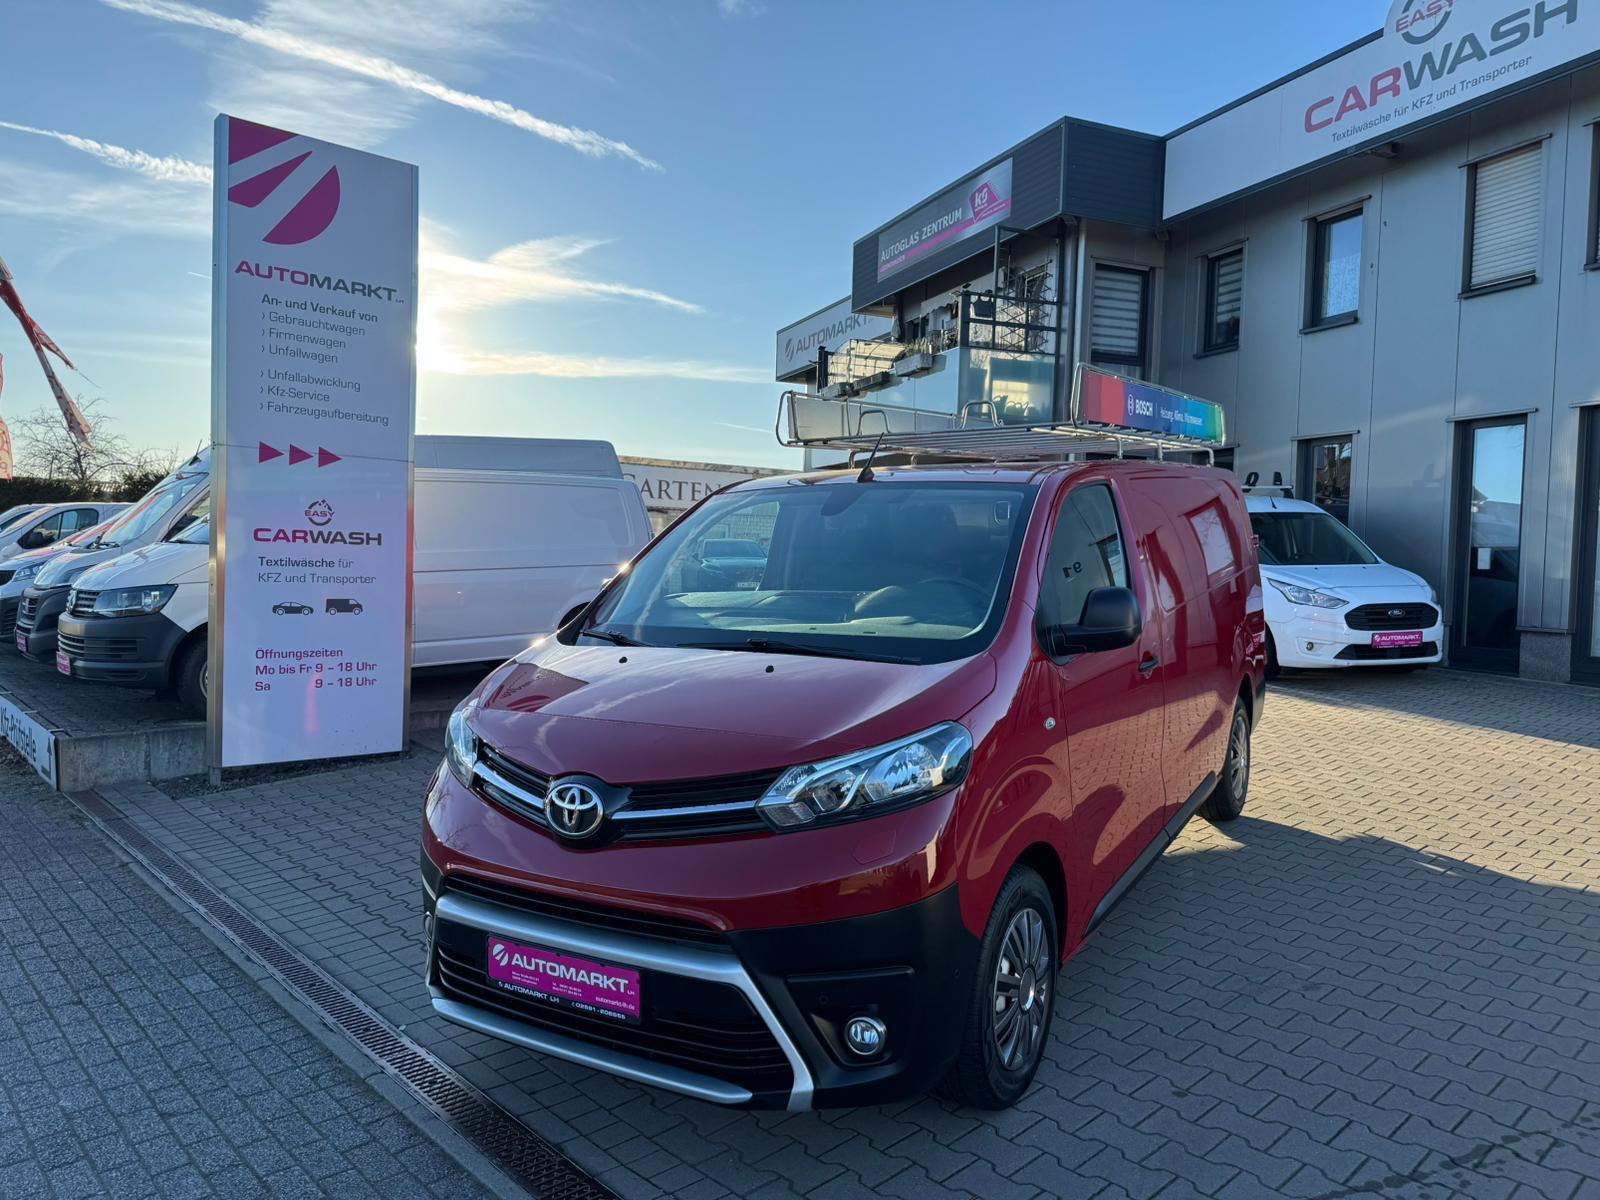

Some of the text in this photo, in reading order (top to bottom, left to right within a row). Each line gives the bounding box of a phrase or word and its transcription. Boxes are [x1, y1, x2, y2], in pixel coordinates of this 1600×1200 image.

[1304, 0, 1578, 133] CARWASH
[1332, 55, 1532, 143] Textilwäsche für KFZ und Transporter
[880, 231, 919, 263] AUTOGLAS
[921, 207, 962, 240] ZENTRUM
[234, 260, 397, 302] AUTOMARKT
[261, 294, 378, 323] An- und Verkauf von
[269, 312, 365, 336] Gebrauchtwagen
[269, 328, 346, 349] Firmenwagen
[269, 344, 338, 363] Unfallwagen
[267, 369, 361, 392] Unfallabwicklung
[267, 386, 330, 402] Kfz-Service
[267, 402, 389, 426] Fahrzeugaufbereitung
[1135, 400, 1153, 417] BOSCH
[304, 509, 335, 518] EASY
[253, 528, 382, 546] CARWASH
[258, 556, 354, 568] Textilwäsche für
[258, 573, 376, 585] KFZ und Transporter
[255, 648, 343, 661] Öffnungszeiten
[255, 665, 275, 675] Mo
[278, 664, 296, 674] bis
[299, 663, 312, 674] Fr
[315, 663, 323, 673] 9
[337, 662, 352, 672] 18
[356, 661, 377, 672] Uhr
[255, 681, 271, 691] Sa
[315, 678, 323, 689] 9
[337, 677, 352, 687] 18
[356, 676, 377, 687] Uhr
[511, 953, 629, 993] AUTOMARKT
[504, 983, 547, 1000] AUTOMARKT
